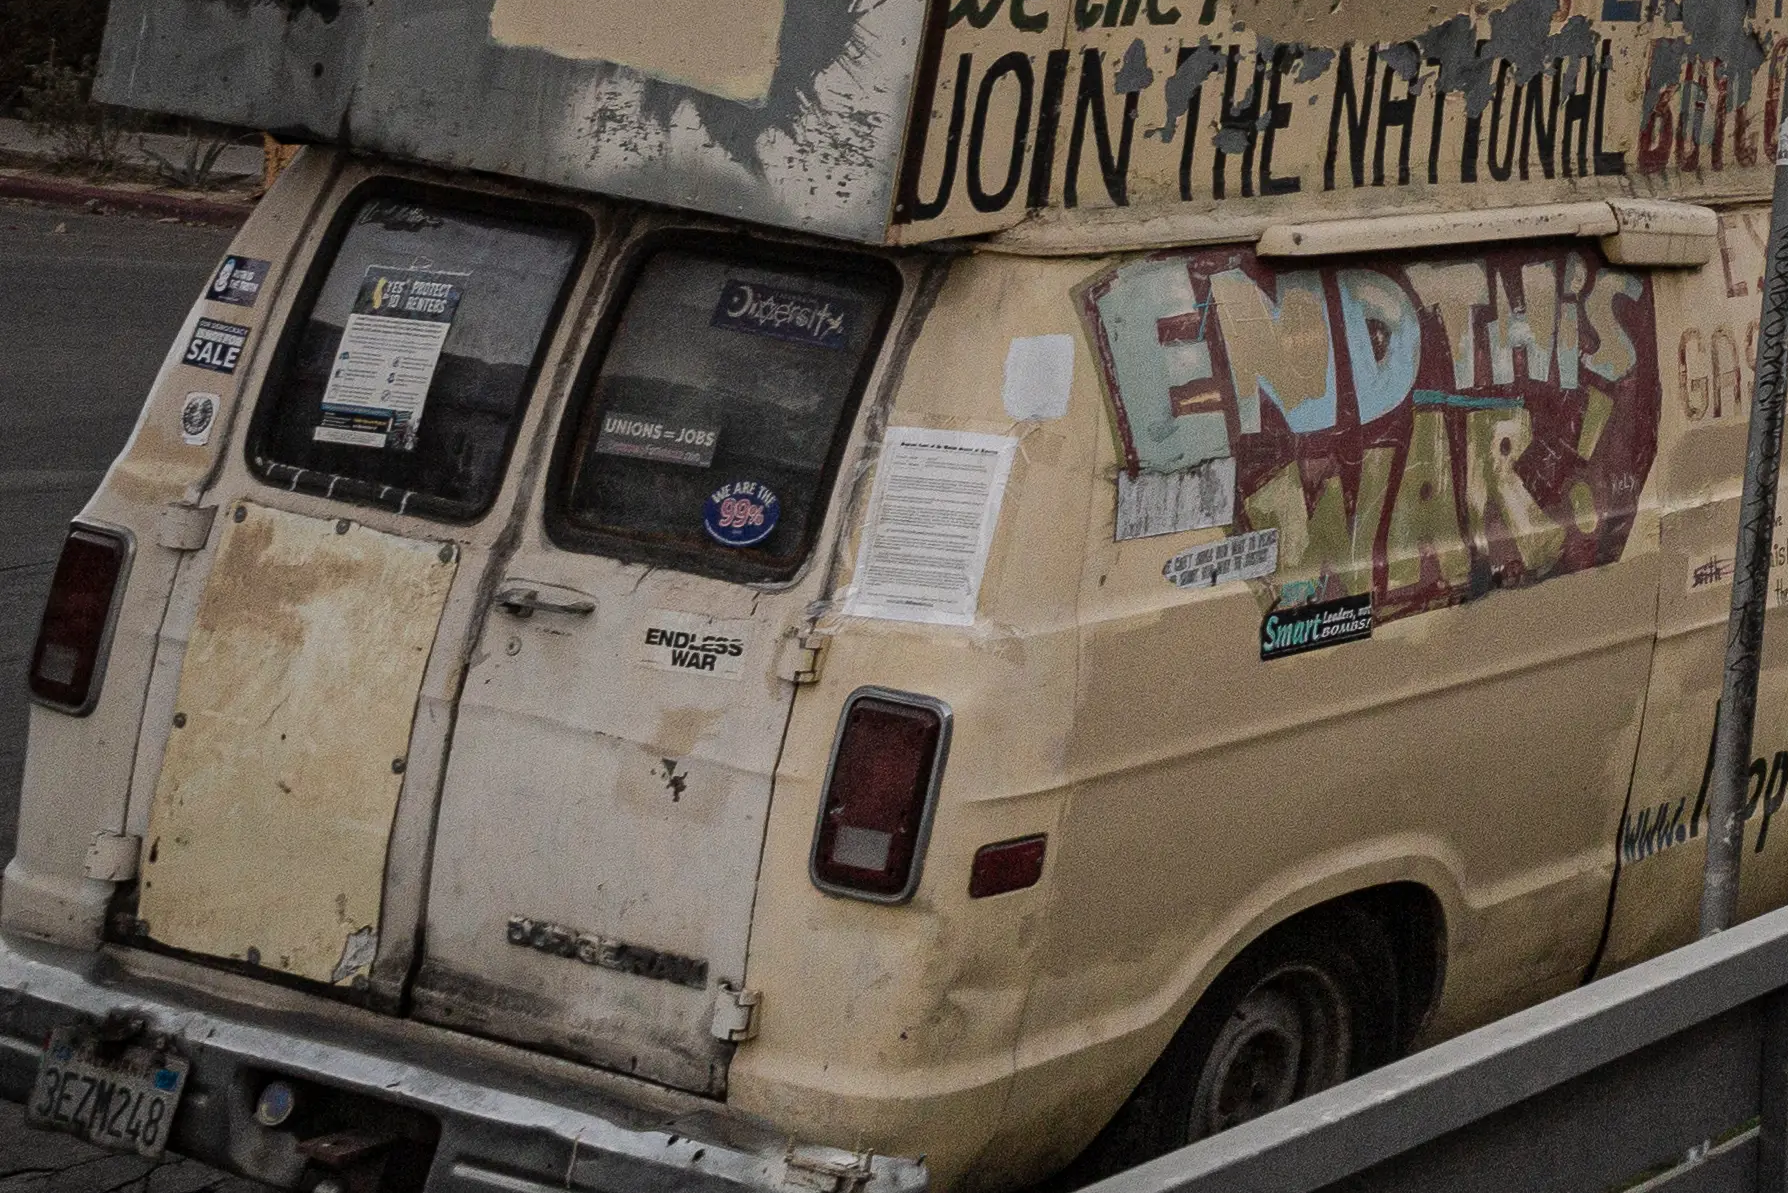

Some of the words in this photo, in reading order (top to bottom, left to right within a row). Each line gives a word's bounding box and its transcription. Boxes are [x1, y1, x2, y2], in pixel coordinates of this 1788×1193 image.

[901, 48, 1139, 220] JOIN
[1177, 42, 1301, 200] THE
[411, 281, 454, 298] PROTECT
[405, 296, 447, 314] RENTERS
[187, 339, 241, 368] SALE
[1097, 260, 1421, 473] END
[712, 484, 731, 504] WE
[732, 481, 757, 495] ARE
[757, 485, 776, 507] THE
[718, 497, 764, 528] 99%
[645, 627, 744, 658] ENDLESS
[1263, 613, 1322, 651] Smart
[1321, 617, 1372, 639] BOMBS!
[671, 650, 717, 672] WAR
